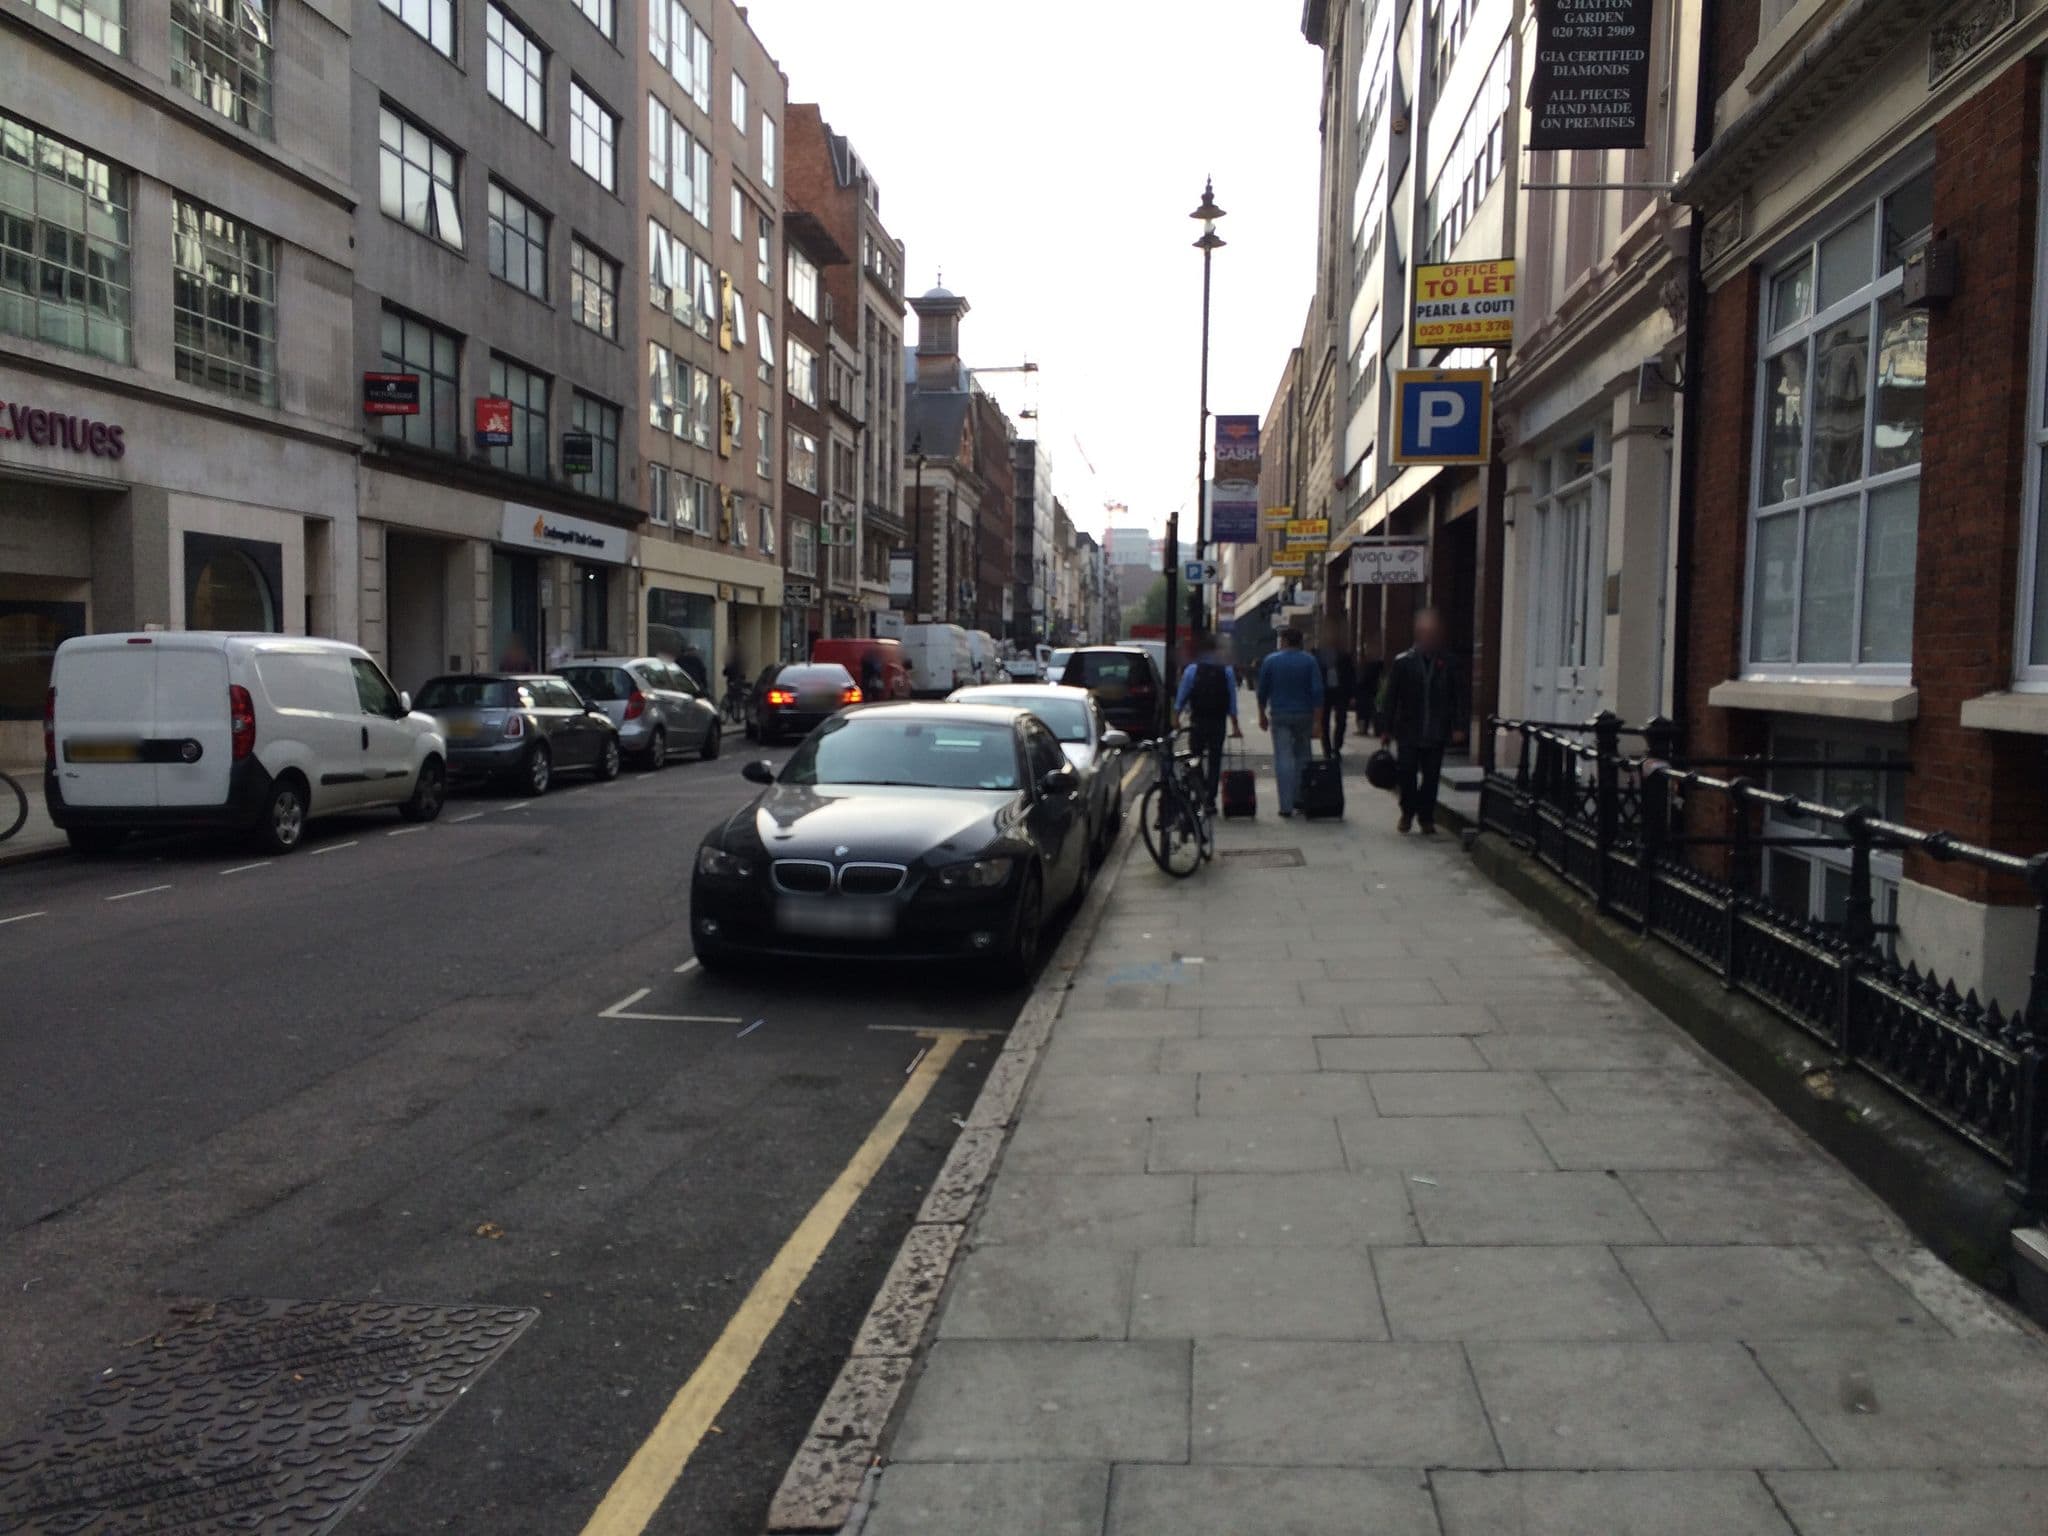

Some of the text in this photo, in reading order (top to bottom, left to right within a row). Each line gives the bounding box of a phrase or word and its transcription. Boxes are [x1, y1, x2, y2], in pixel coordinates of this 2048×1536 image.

[1574, 0, 1633, 9] HATTON
[1564, 11, 1624, 23] GARDEN
[1552, 25, 1635, 37] 020 7831 2909
[1540, 50, 1645, 62] GIA CERTIFIED
[1553, 64, 1630, 77] DIAMONDS
[1550, 88, 1630, 101] ALL PIECES
[1545, 102, 1632, 115] HAND MADE
[1541, 116, 1636, 129] ON PREMISES
[1442, 263, 1497, 278] OFFICE
[1424, 275, 1515, 298] TO LET
[1417, 303, 1457, 318] PEARL
[1461, 302, 1470, 315] &
[1420, 319, 1513, 336] 020 7843 378
[1417, 390, 1465, 448] P
